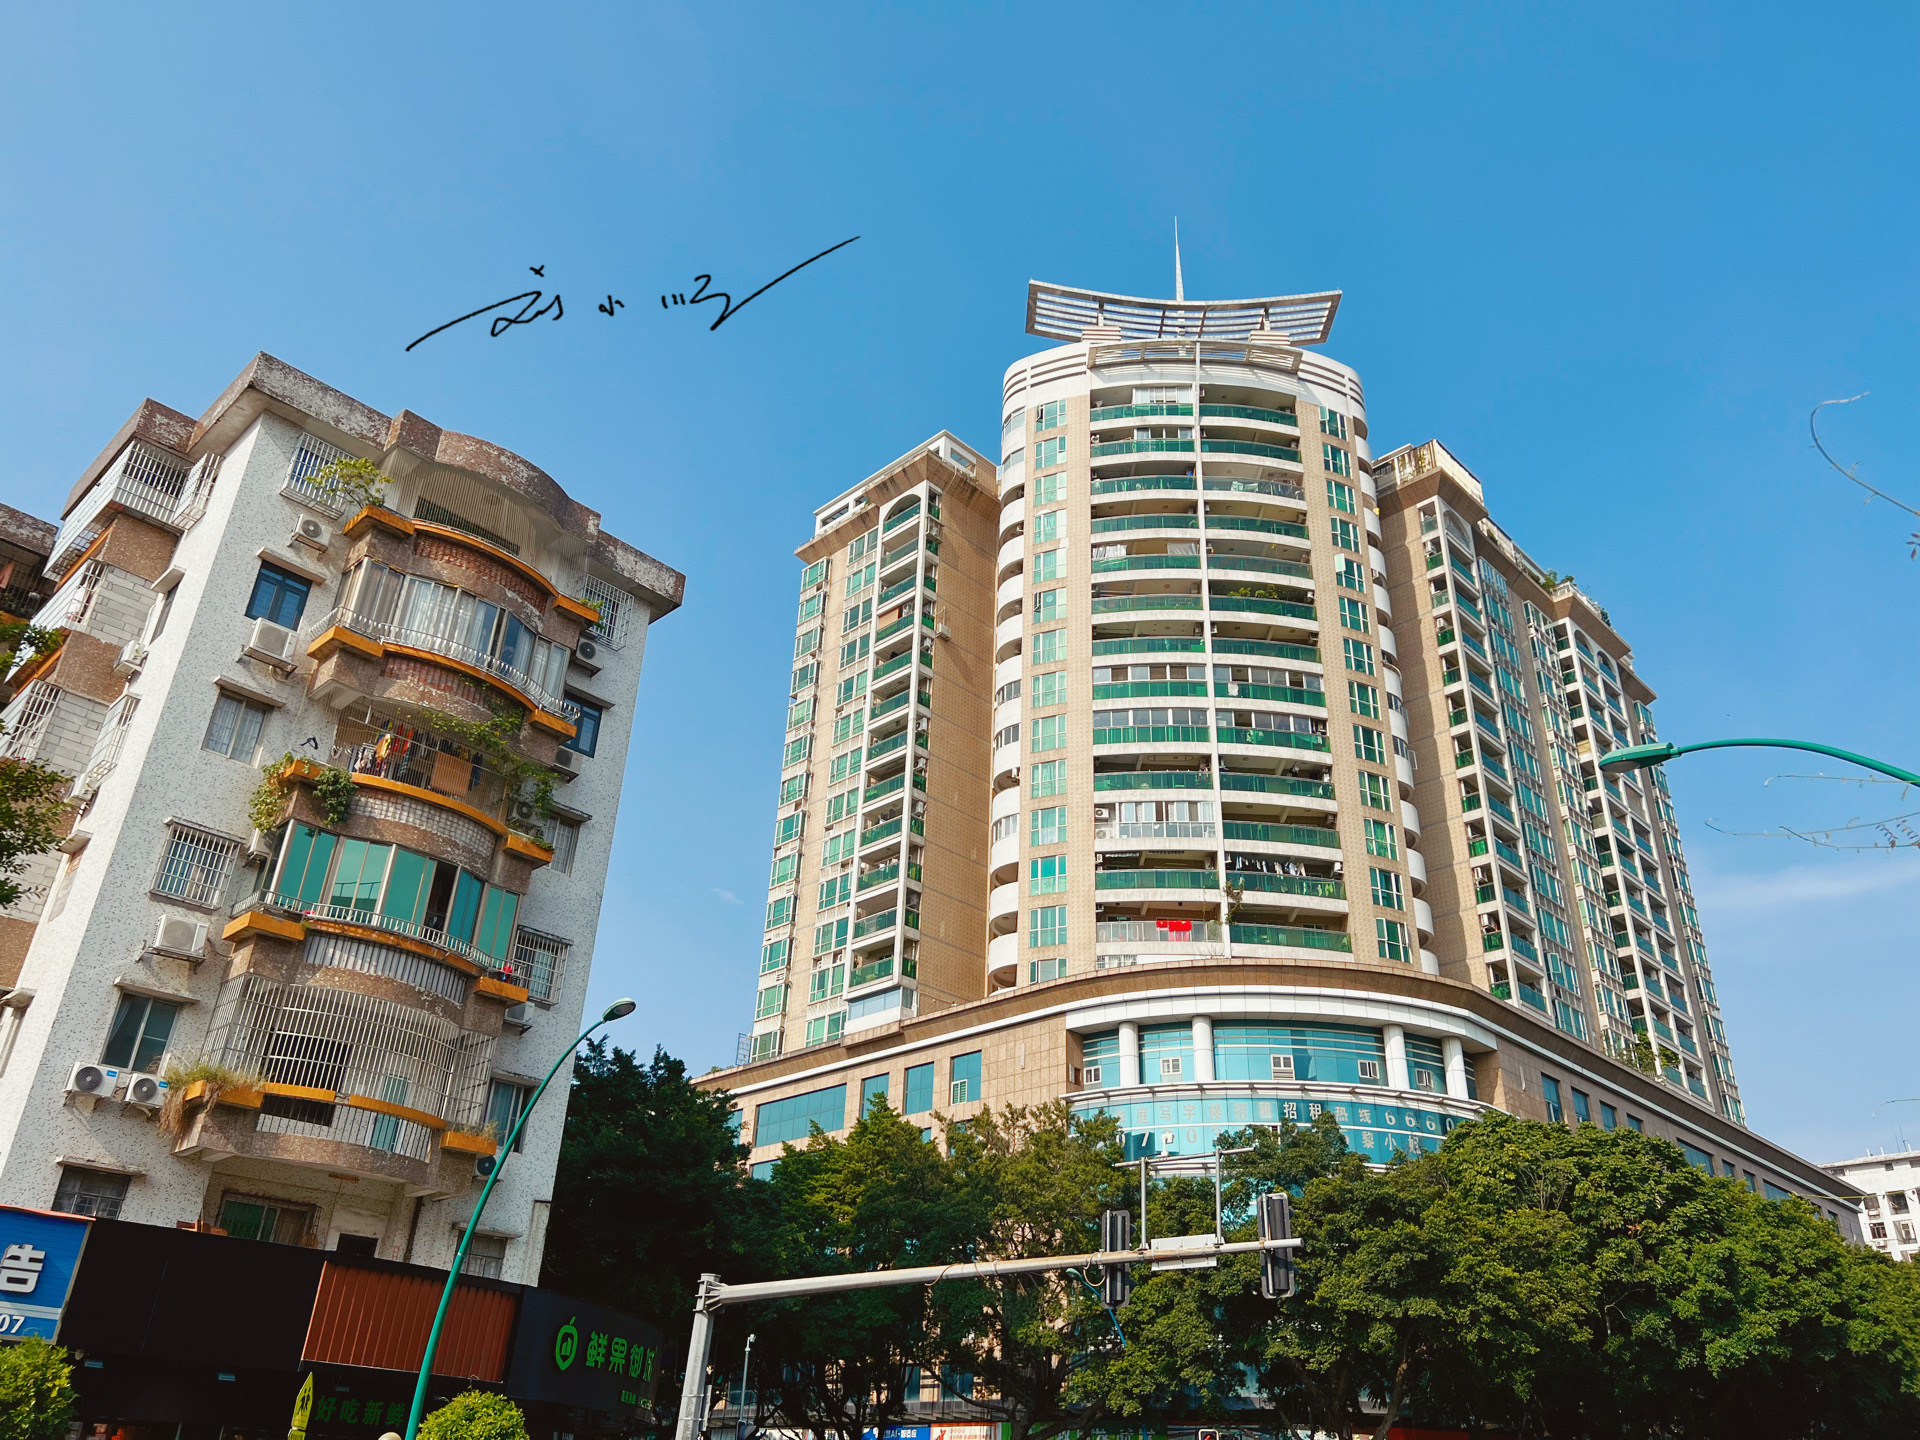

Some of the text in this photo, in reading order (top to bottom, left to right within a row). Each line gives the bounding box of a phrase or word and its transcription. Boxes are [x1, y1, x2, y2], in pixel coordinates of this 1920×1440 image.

[0, 1244, 46, 1293] 告
[0, 1314, 25, 1334] 07
[314, 1395, 406, 1427] 好吃新鲜
